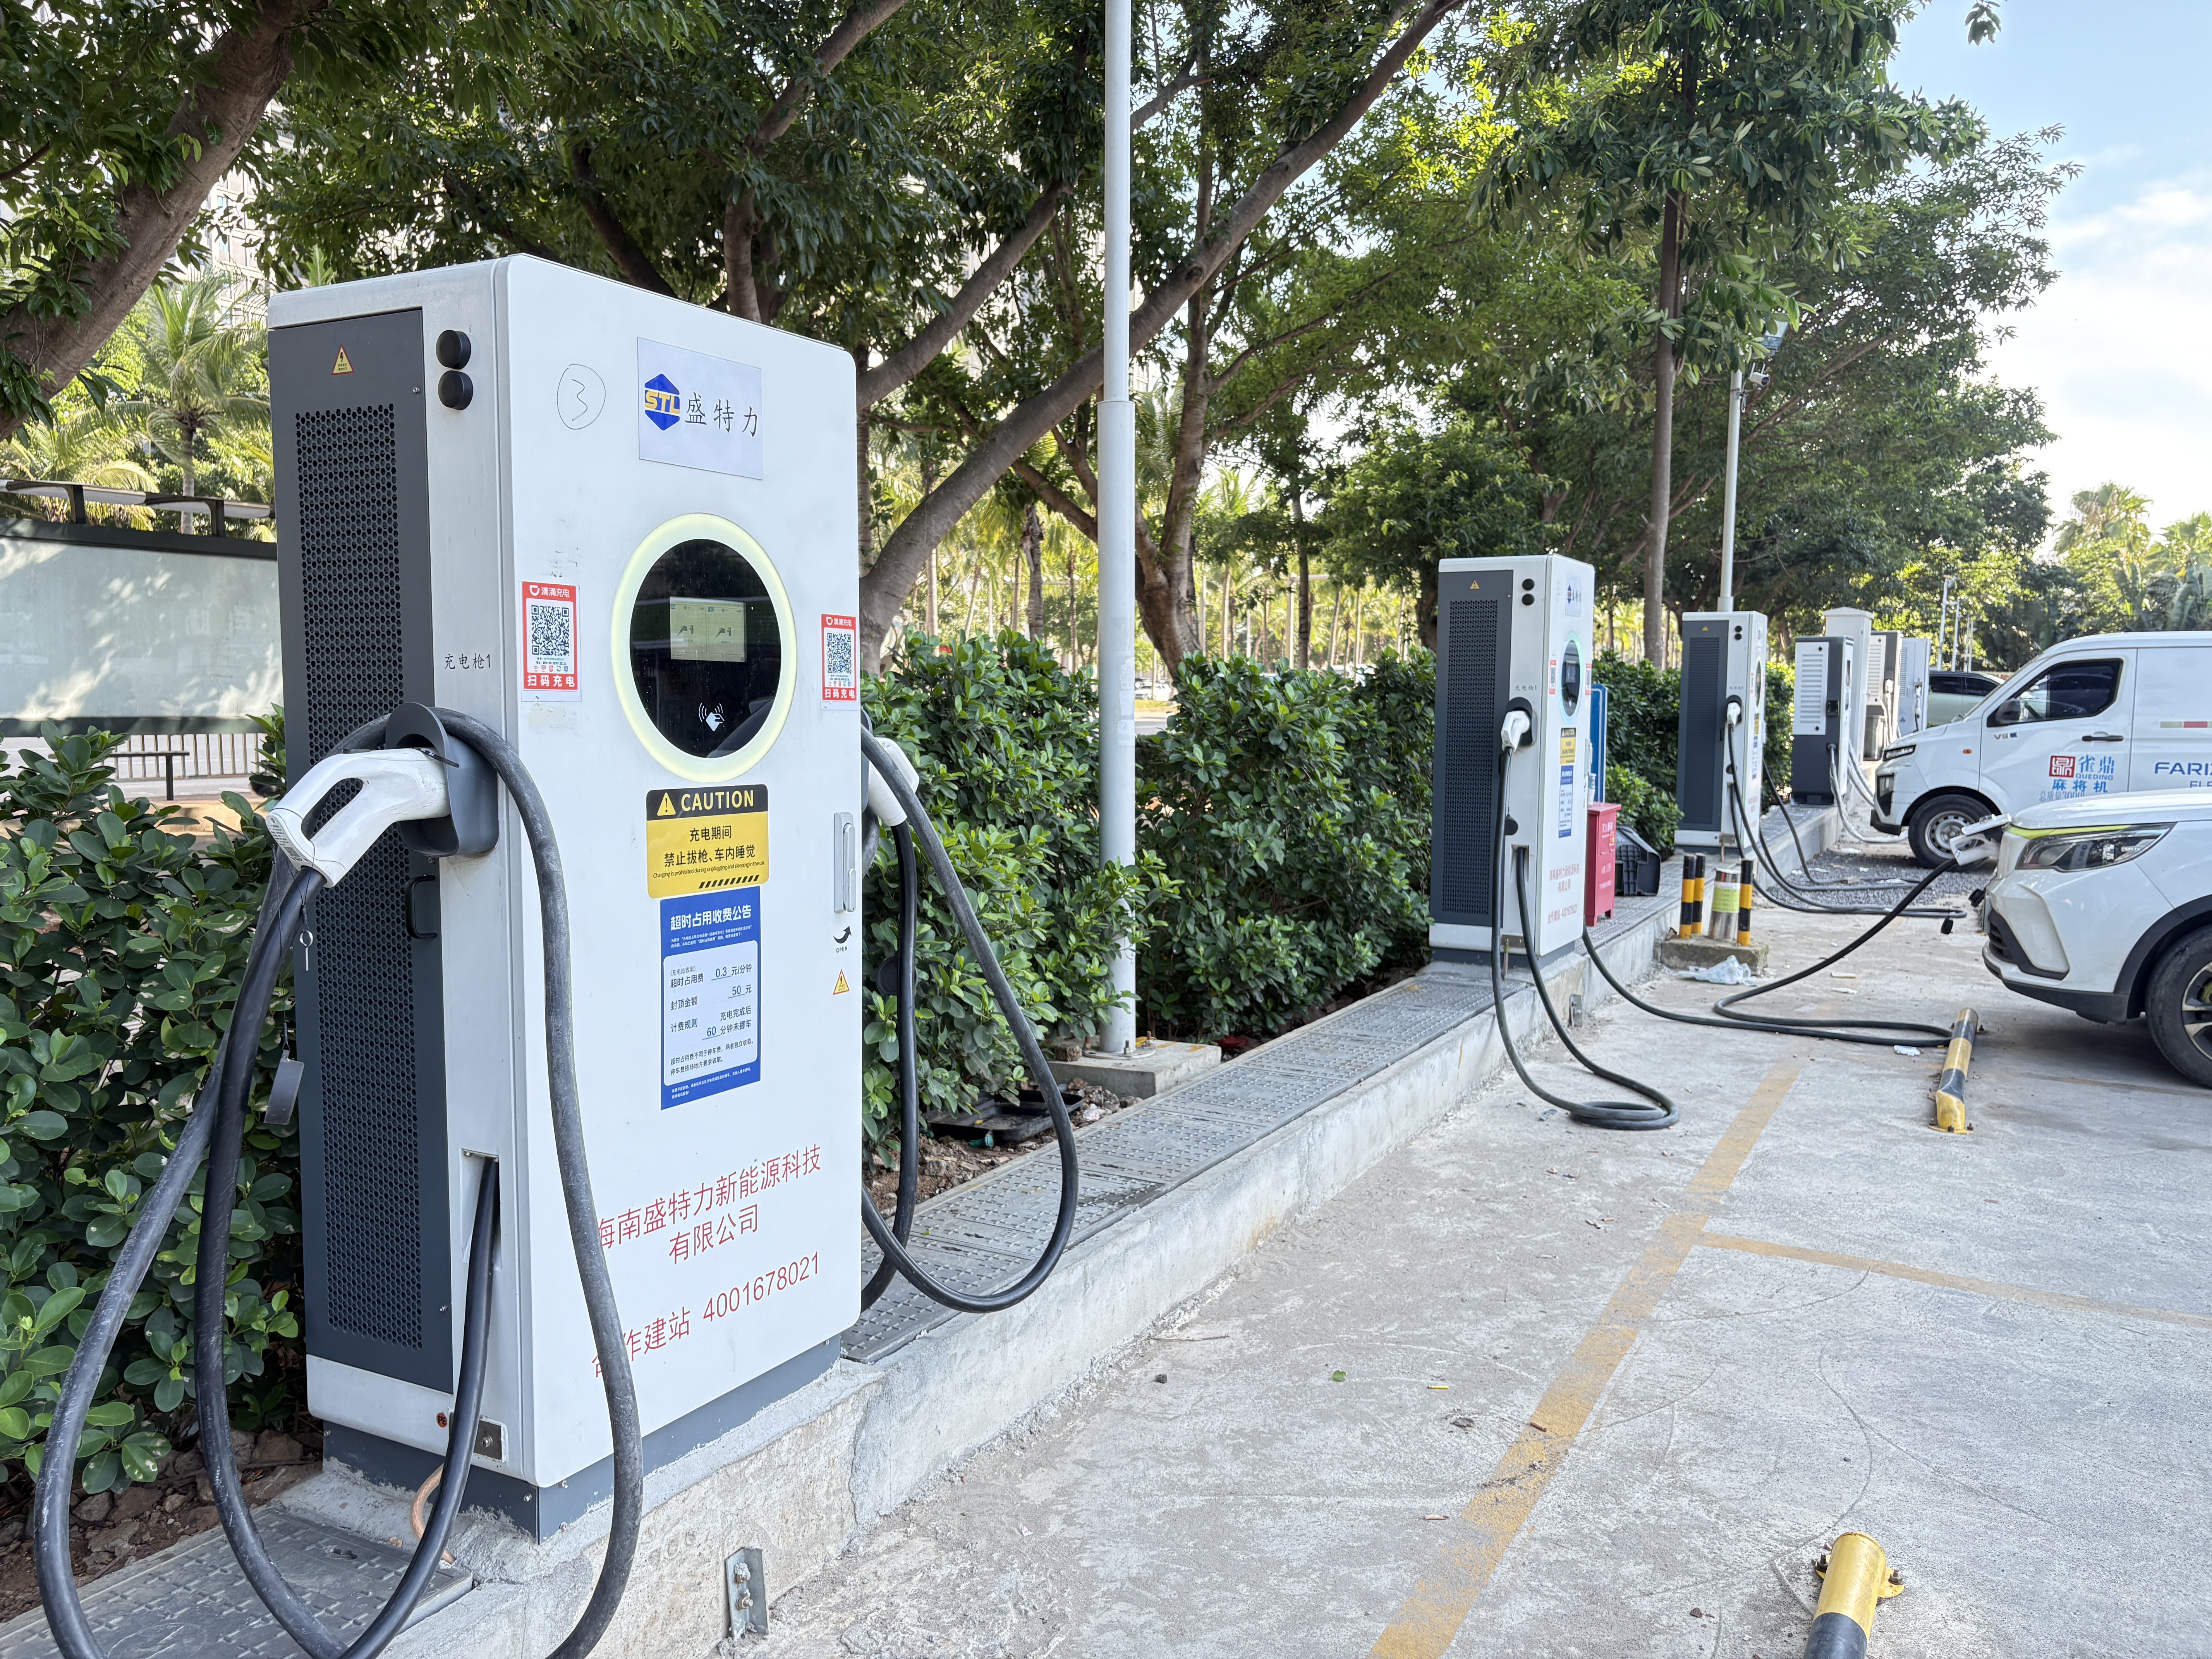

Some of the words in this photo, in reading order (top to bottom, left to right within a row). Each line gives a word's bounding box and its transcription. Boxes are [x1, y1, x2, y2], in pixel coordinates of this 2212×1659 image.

[572, 378, 588, 421] 3
[644, 390, 680, 414] STL
[684, 392, 758, 437] 盛特力
[541, 587, 570, 598] 滴滴充电
[833, 618, 852, 627] 滴滴充电
[444, 653, 490, 670] 充电枪1
[527, 674, 575, 687] 扫码充电
[824, 688, 855, 699] 扫码充电
[2052, 779, 2108, 793] 麻将机
[681, 790, 754, 812] CAUTION
[689, 825, 732, 842] 充电期间
[664, 844, 755, 867] 禁止拔枪、车内睡觉
[670, 904, 752, 931] 超时占用收费公告
[670, 973, 704, 988] 超时占用费
[715, 967, 727, 978] 0.3
[731, 963, 752, 976] 元/分钟
[670, 996, 698, 1011] 封顶金额
[732, 985, 741, 996] 50
[745, 984, 752, 994] 元
[720, 1005, 752, 1021] 充电完成后
[670, 1017, 698, 1033] 计费规则
[707, 1026, 716, 1037] 60
[669, 1204, 758, 1264] 有限公司
[703, 1251, 819, 1322] 4001678021
[438, 1415, 447, 1425] PE
